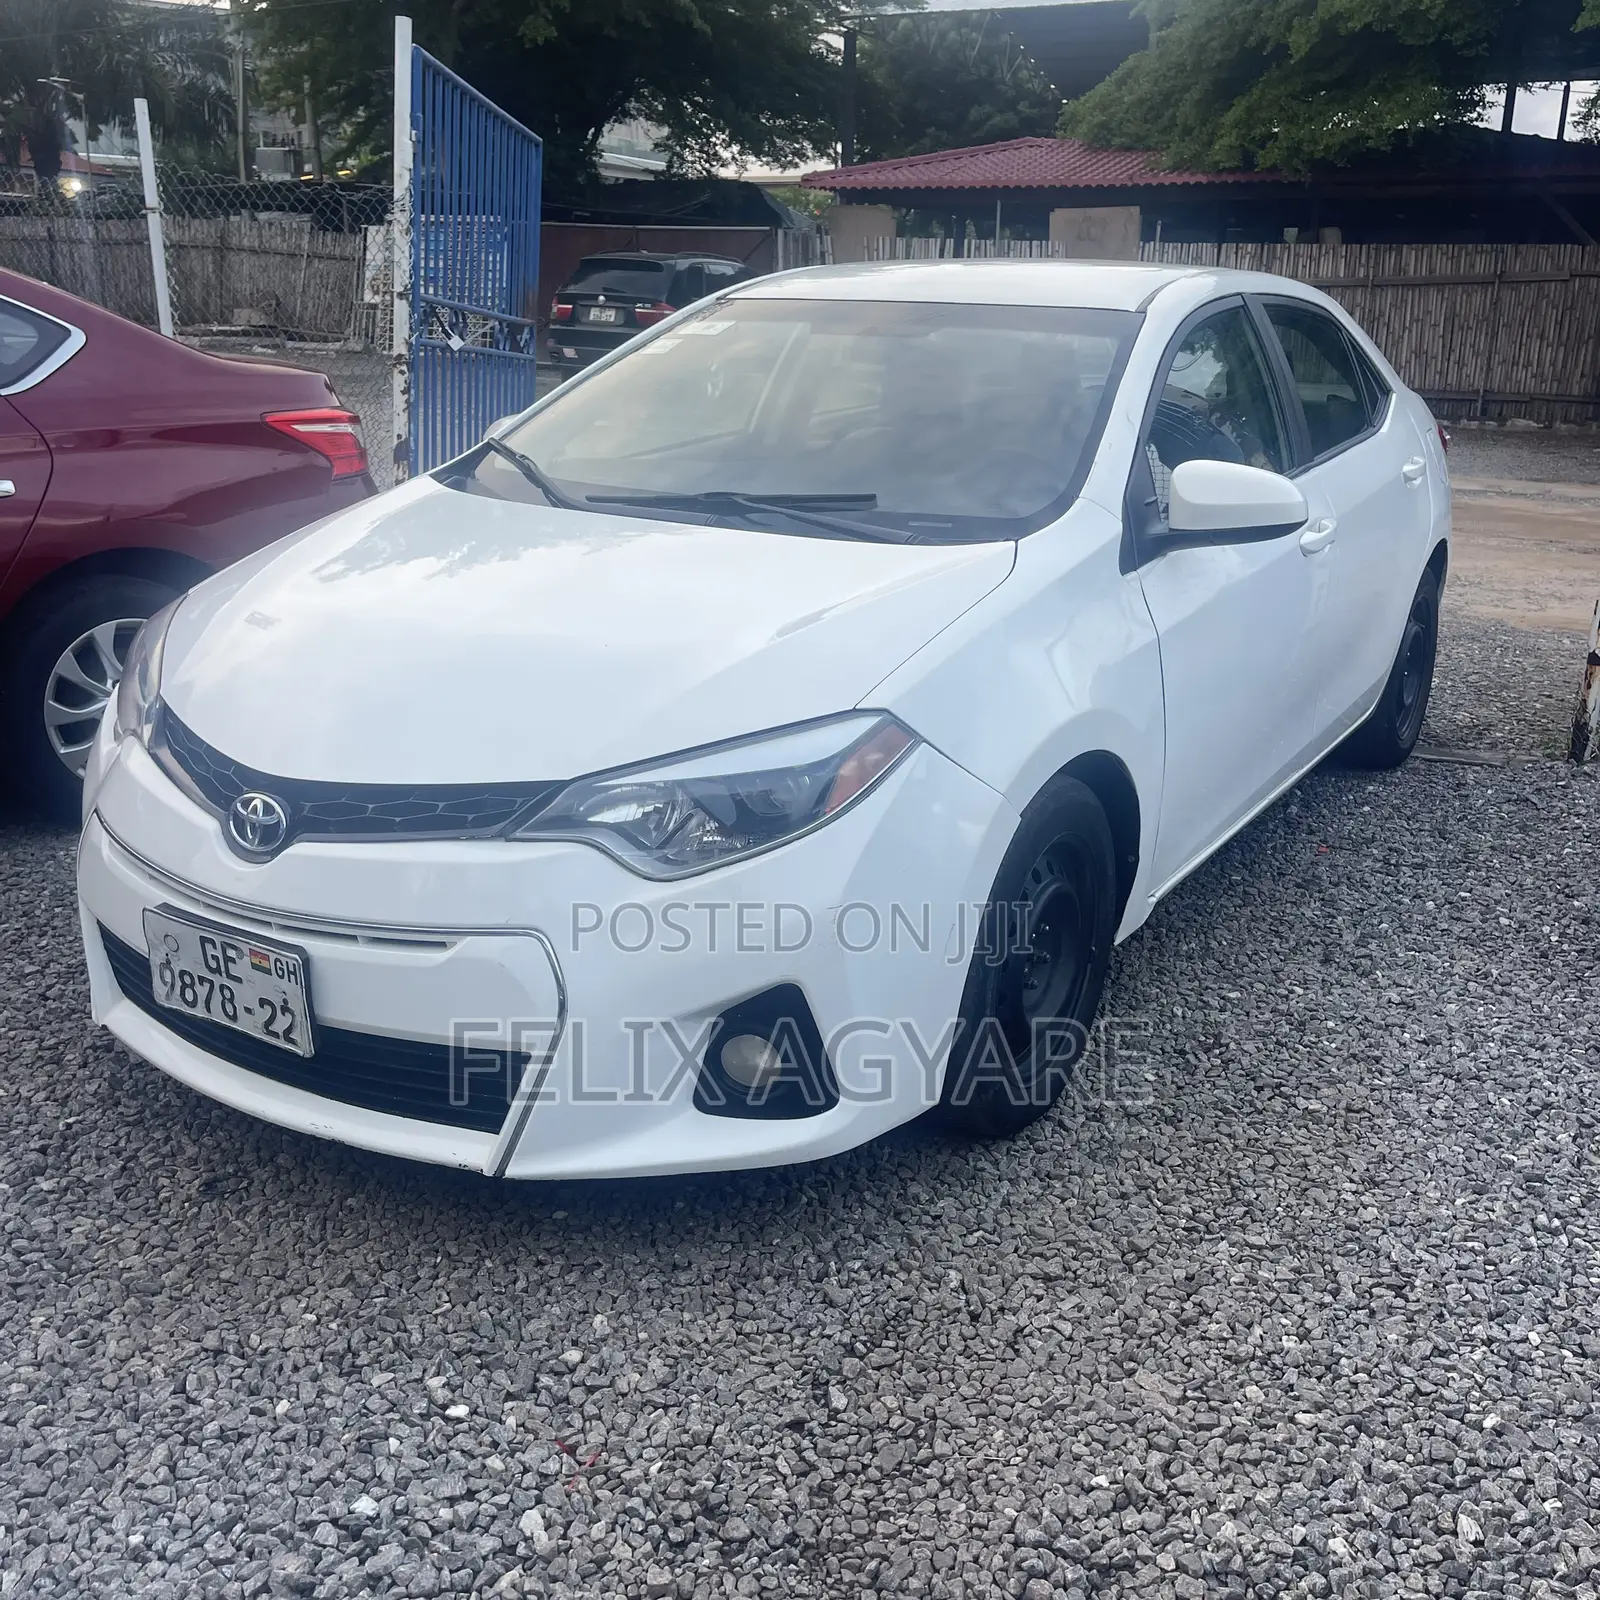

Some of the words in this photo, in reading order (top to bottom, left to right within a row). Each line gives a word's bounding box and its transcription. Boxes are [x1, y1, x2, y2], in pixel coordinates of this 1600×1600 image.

[199, 935, 243, 984] GE
[274, 957, 299, 986] GH
[159, 961, 300, 1046] 9878-22
